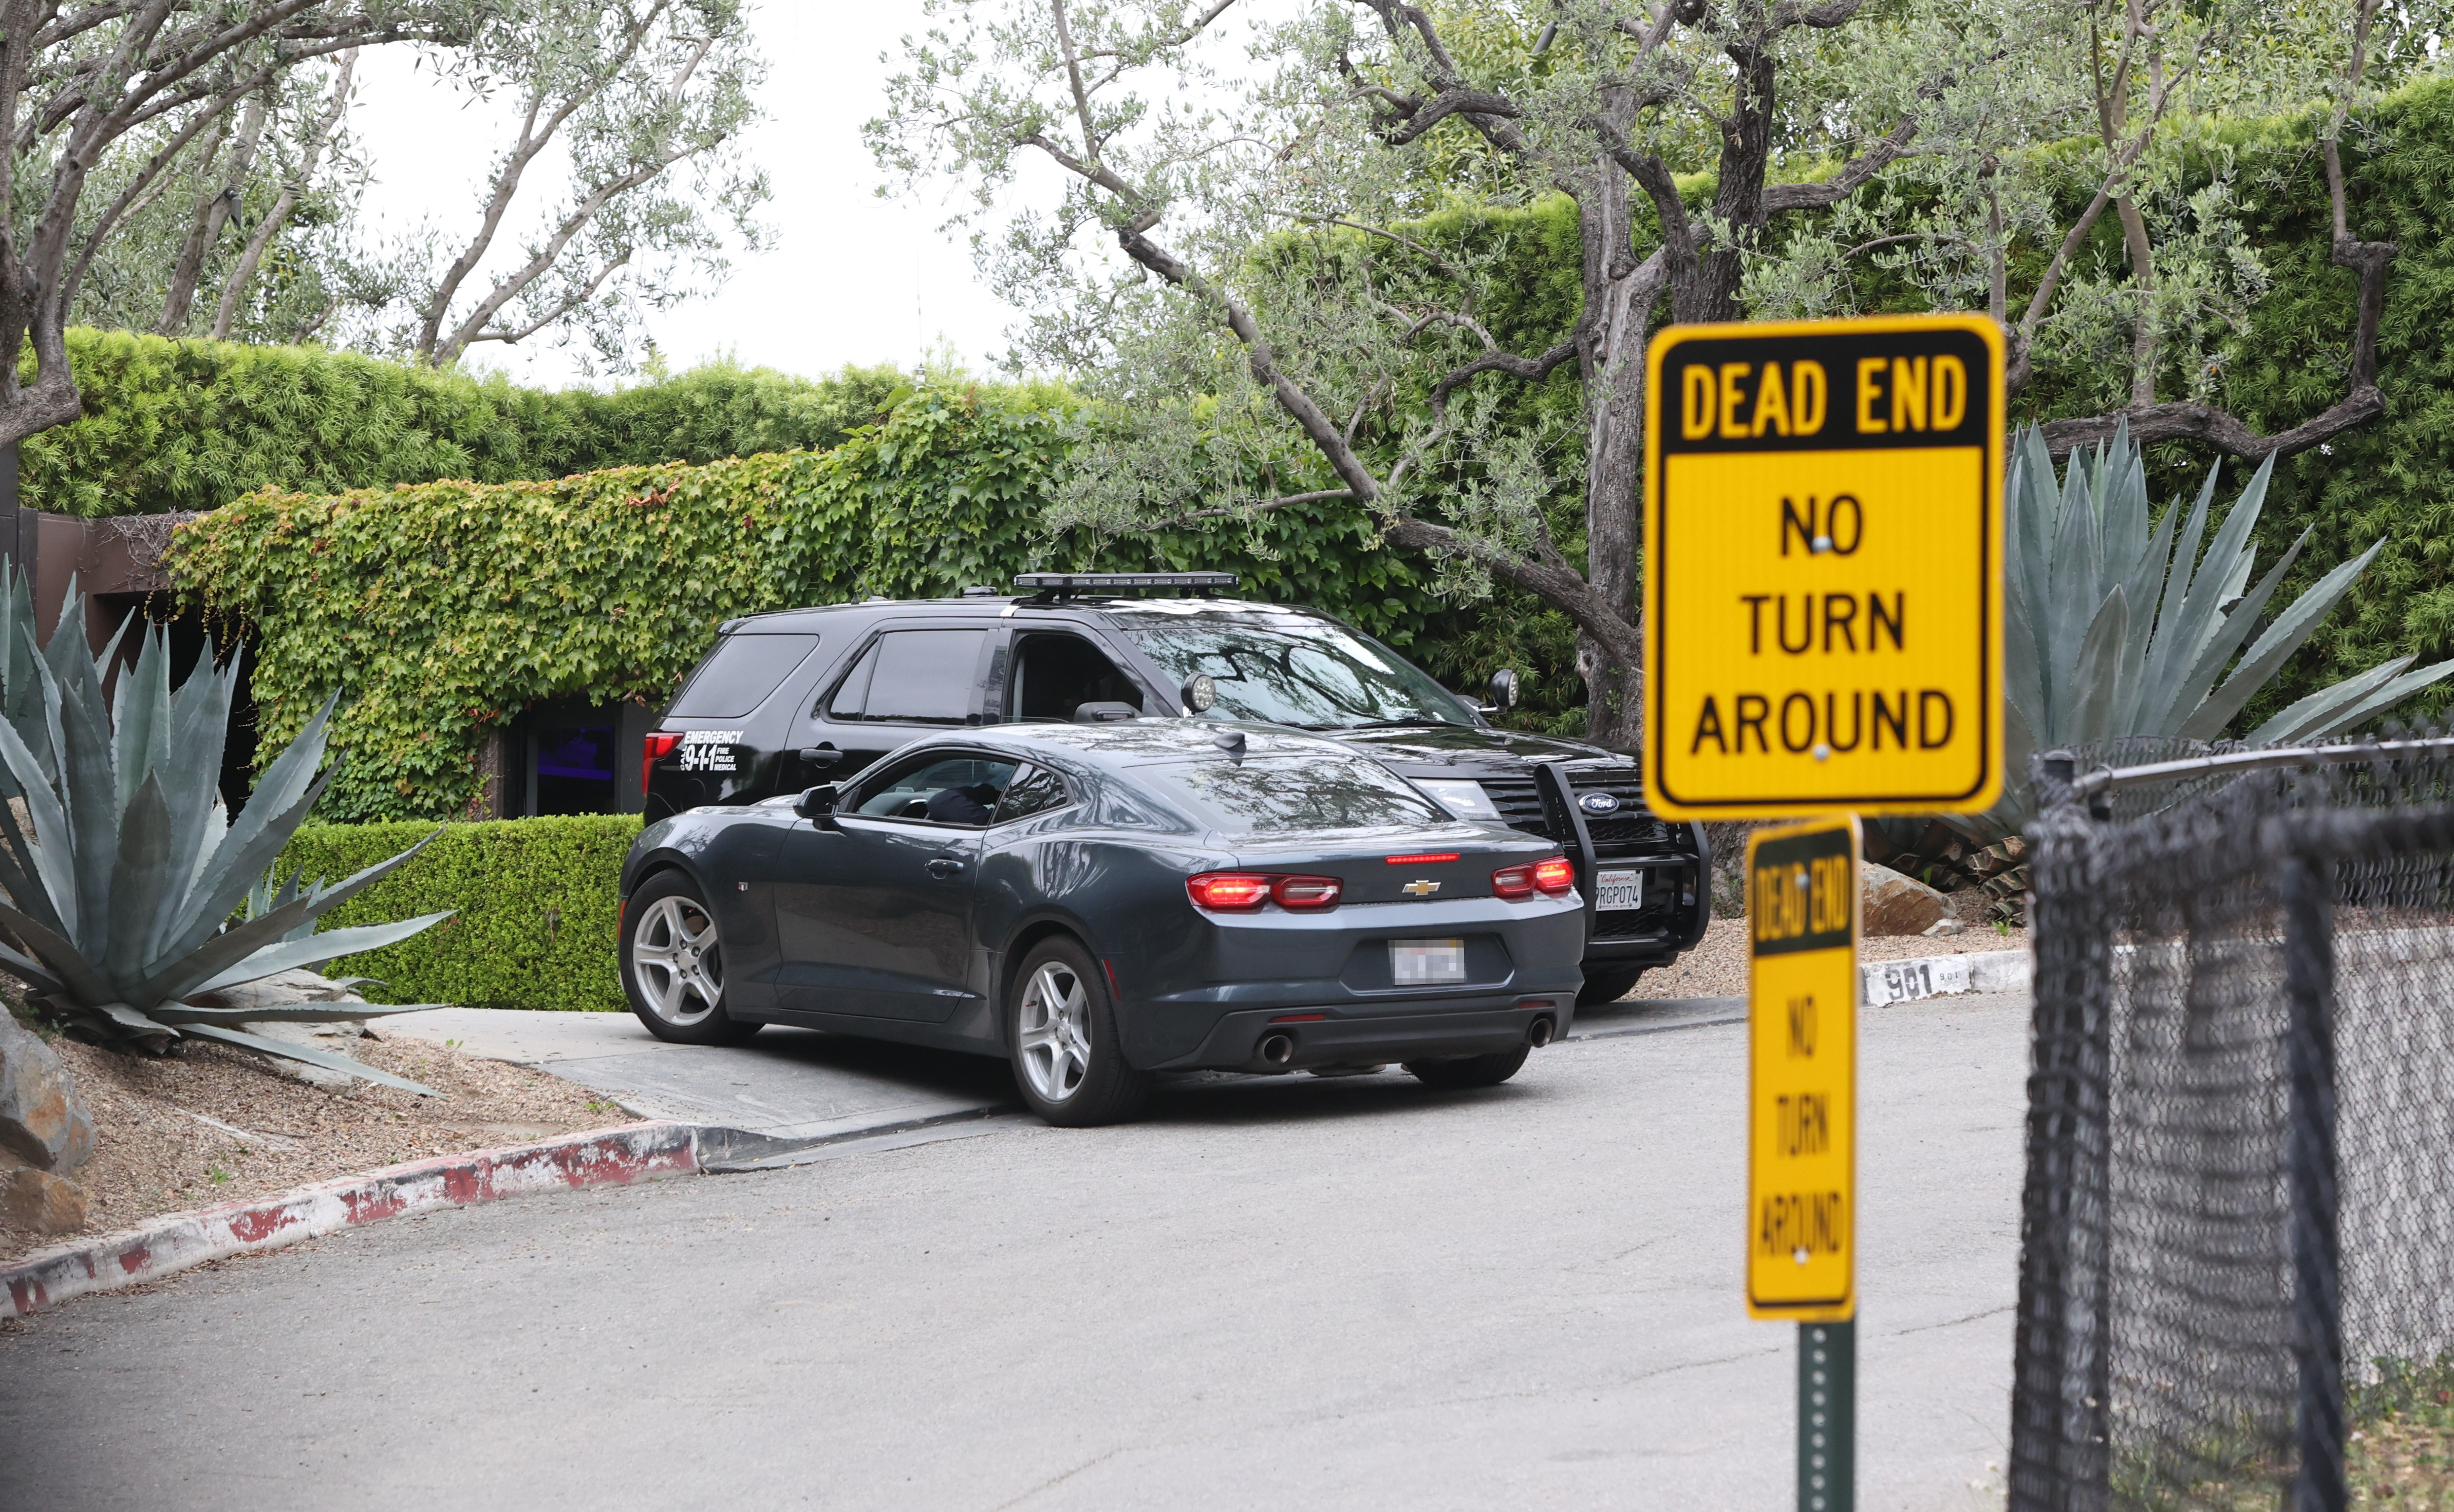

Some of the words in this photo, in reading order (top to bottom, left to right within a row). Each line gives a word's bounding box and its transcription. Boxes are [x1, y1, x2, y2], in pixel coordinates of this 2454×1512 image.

[1680, 359, 1829, 441] DEAD
[1855, 353, 1968, 434] END
[1779, 493, 1865, 558] NO
[1739, 591, 1905, 656] TURN
[684, 730, 744, 744] EMERGENCY
[1690, 689, 1955, 756] AROUND
[684, 744, 718, 771] 9-1-1
[1591, 798, 1613, 809] Ford
[1601, 874, 1633, 885] California
[1756, 863, 1805, 942] DEAD
[1811, 855, 1848, 933] END
[1885, 964, 1932, 1000] 901
[1786, 994, 1819, 1060] NO
[1775, 1092, 1830, 1158] TURN
[1759, 1190, 1843, 1258] AROUND
